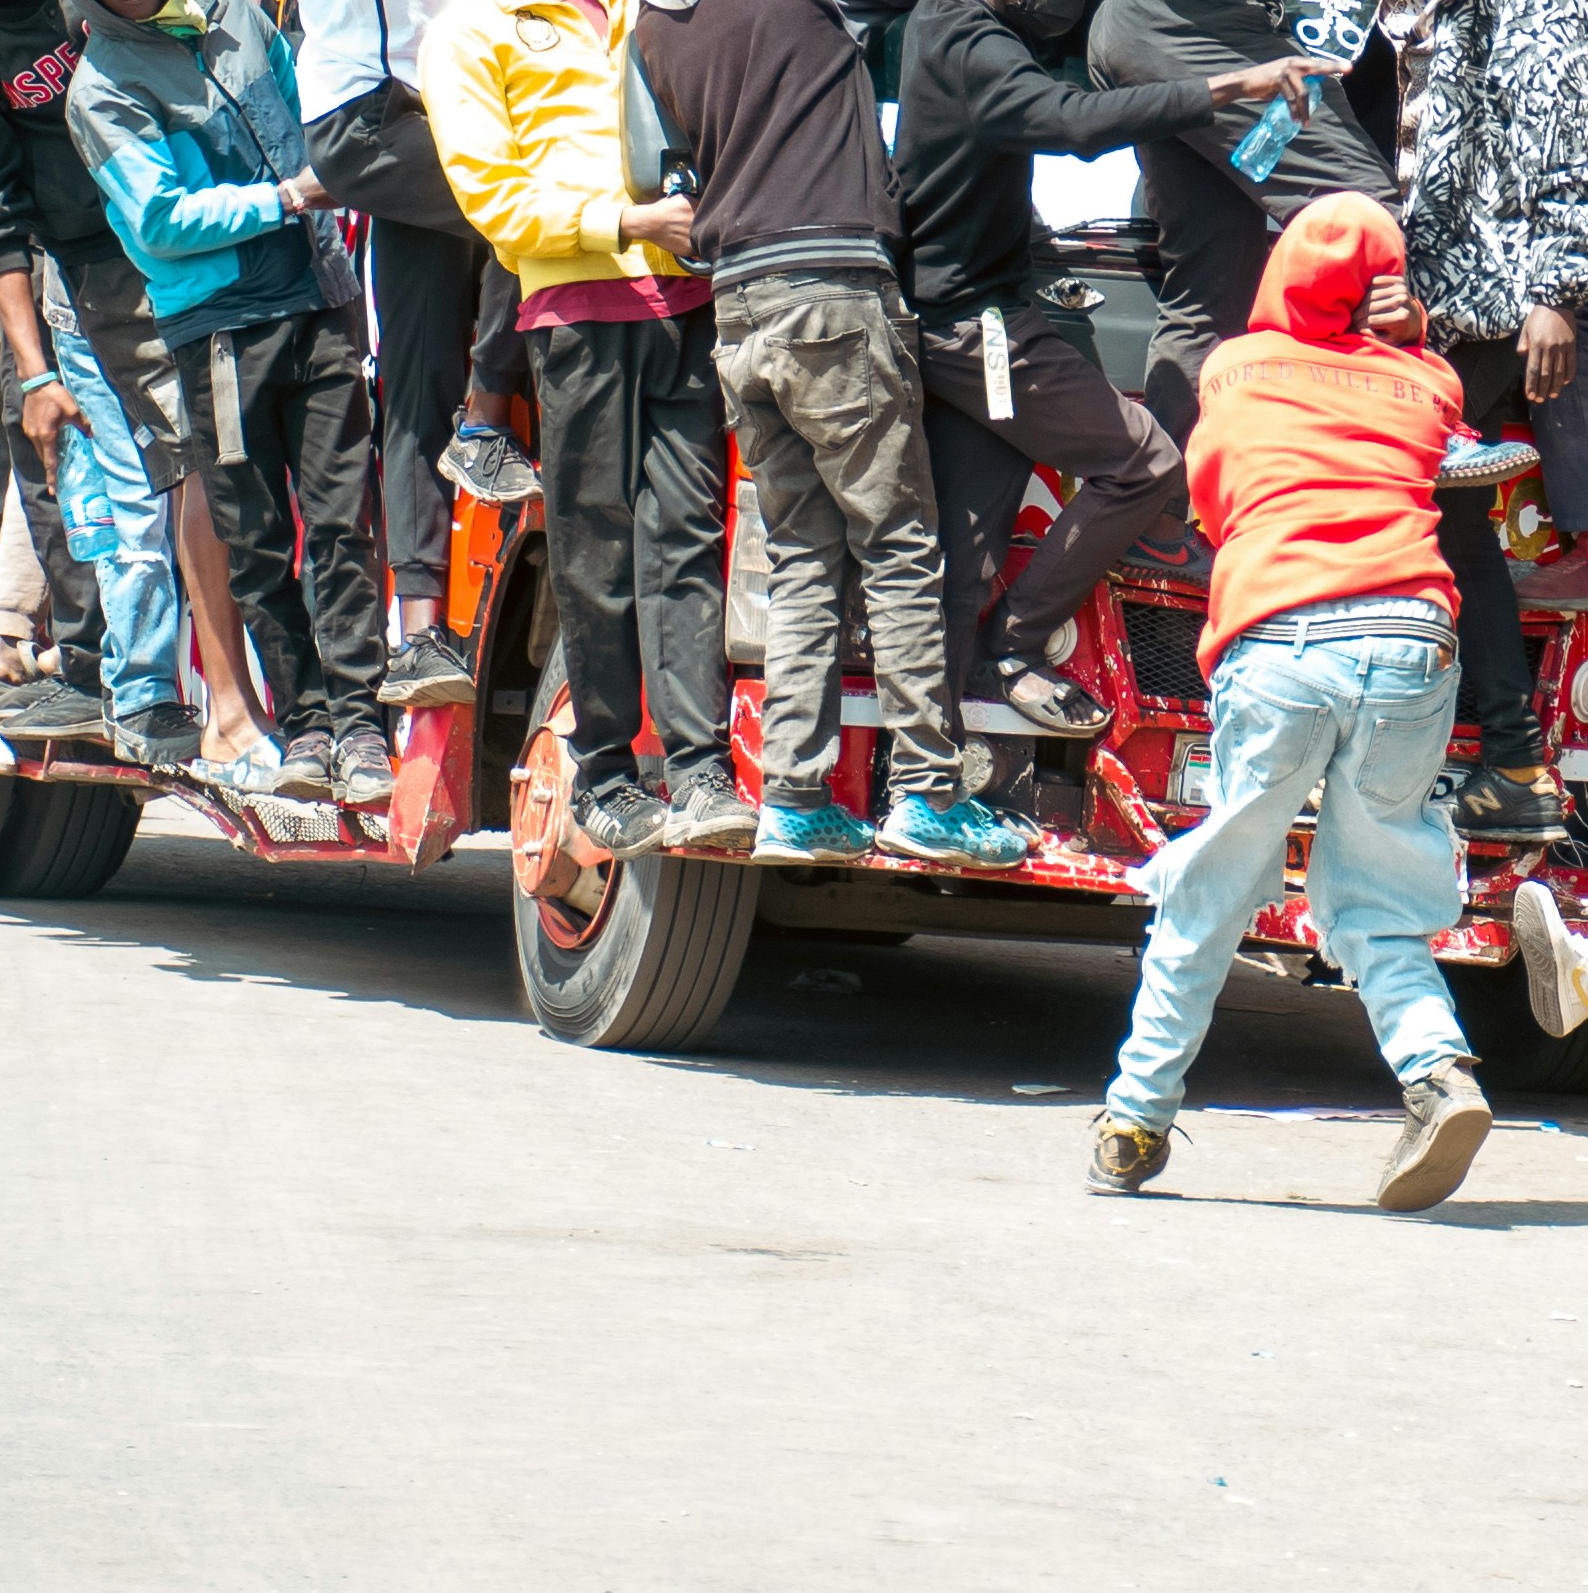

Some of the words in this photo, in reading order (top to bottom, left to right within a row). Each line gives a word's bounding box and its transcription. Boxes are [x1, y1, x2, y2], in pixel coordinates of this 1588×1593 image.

[1210, 362, 1294, 396] WORLD
[1308, 365, 1379, 393] WILL
[1393, 379, 1423, 404] BE
